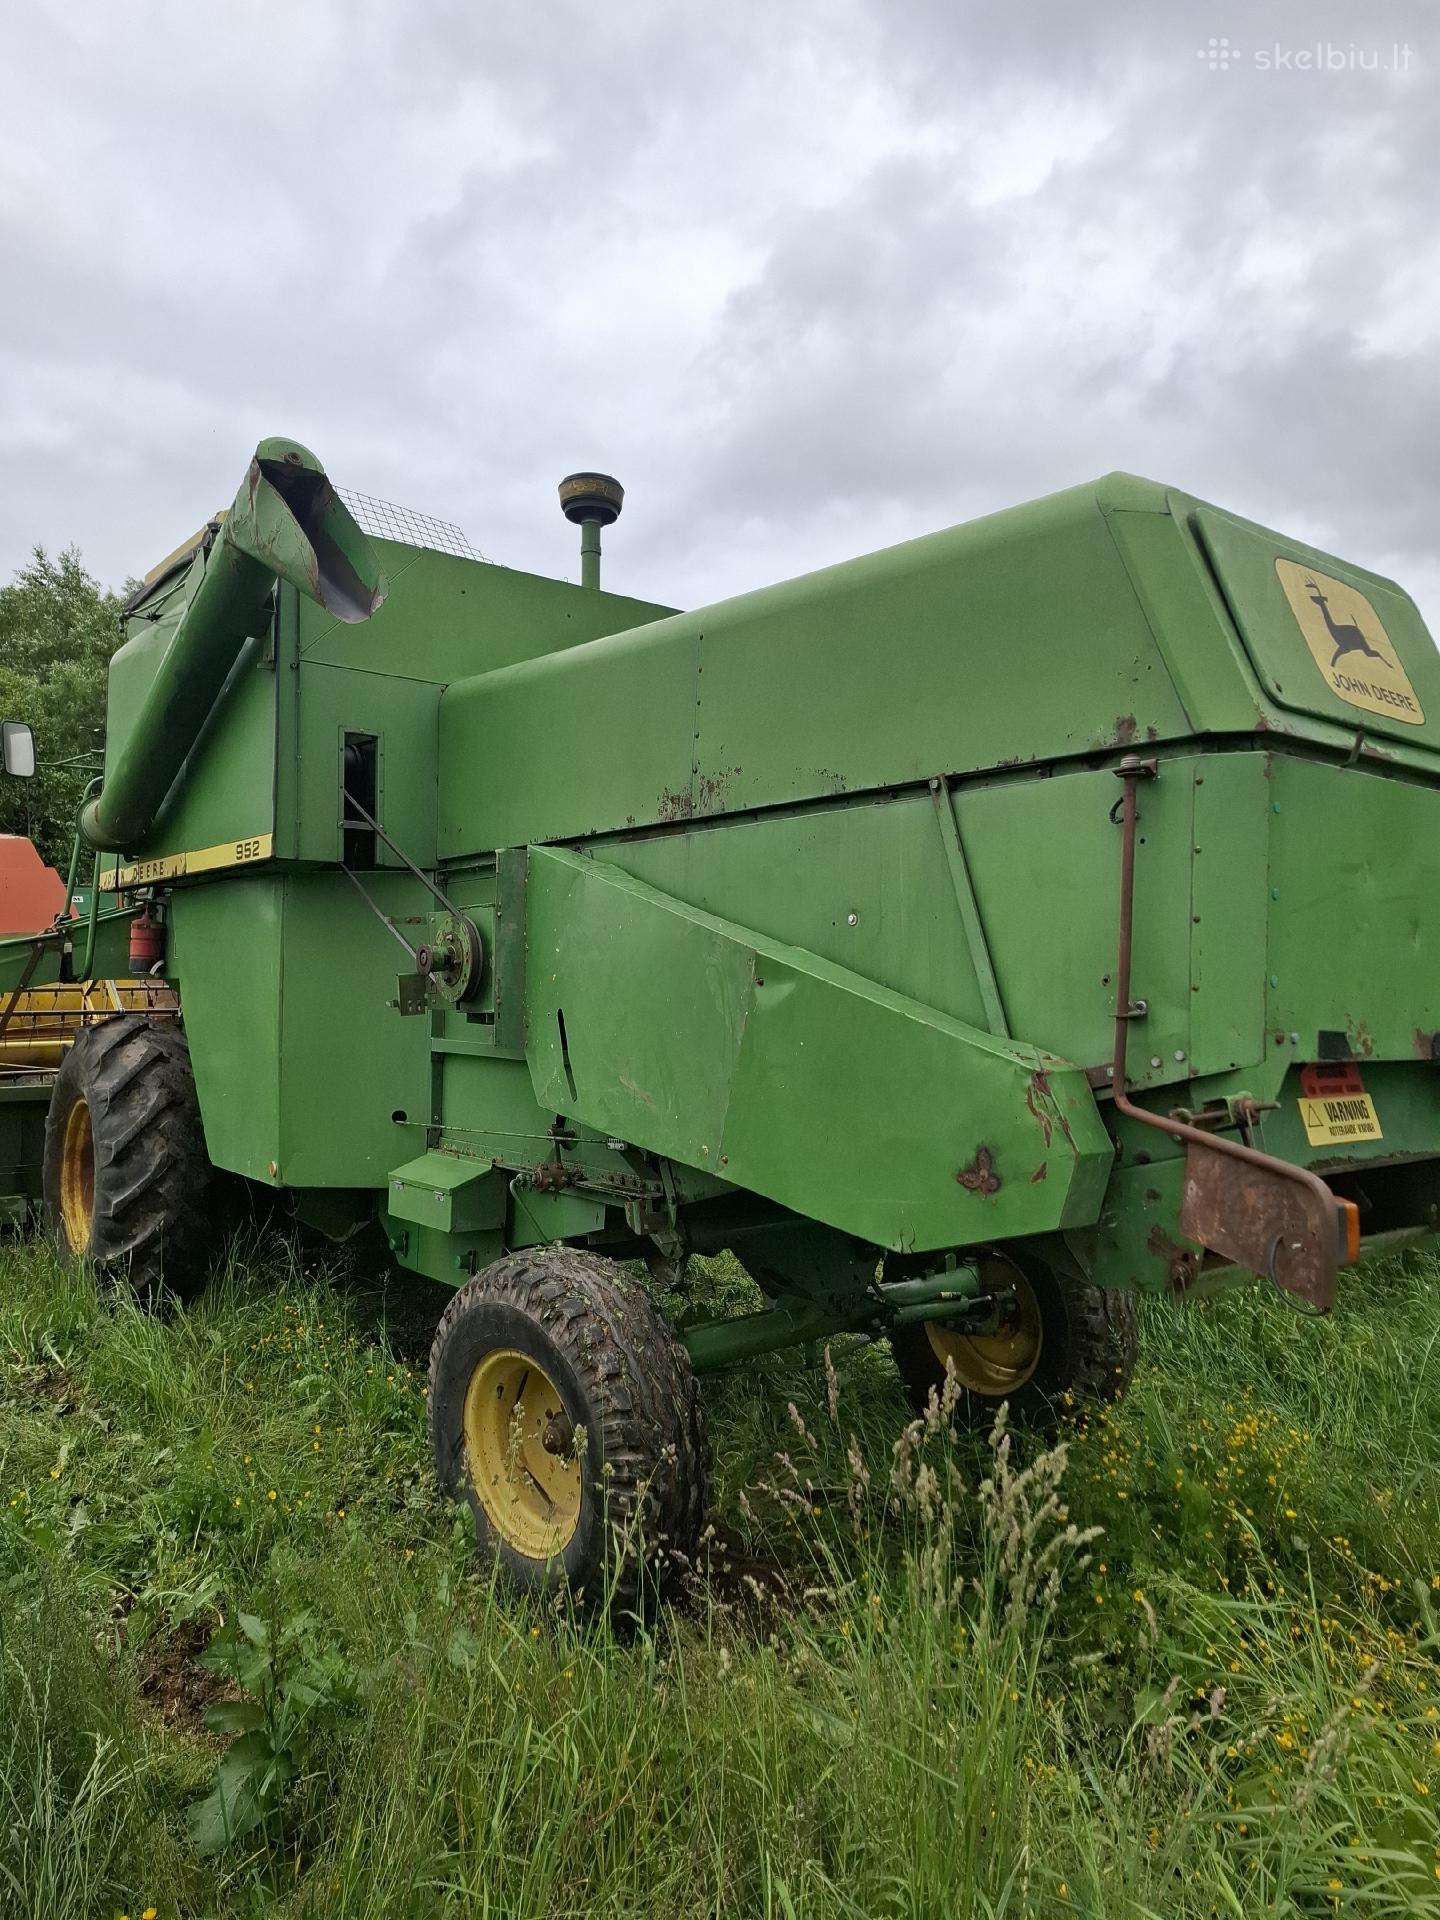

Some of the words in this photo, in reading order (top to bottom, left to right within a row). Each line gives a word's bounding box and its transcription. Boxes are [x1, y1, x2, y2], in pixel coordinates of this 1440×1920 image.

[1333, 671, 1372, 698] JOHN
[1371, 684, 1418, 713] DEERE
[235, 840, 260, 861] 952
[131, 861, 164, 883] DEERE
[1323, 1099, 1371, 1123] VARNING
